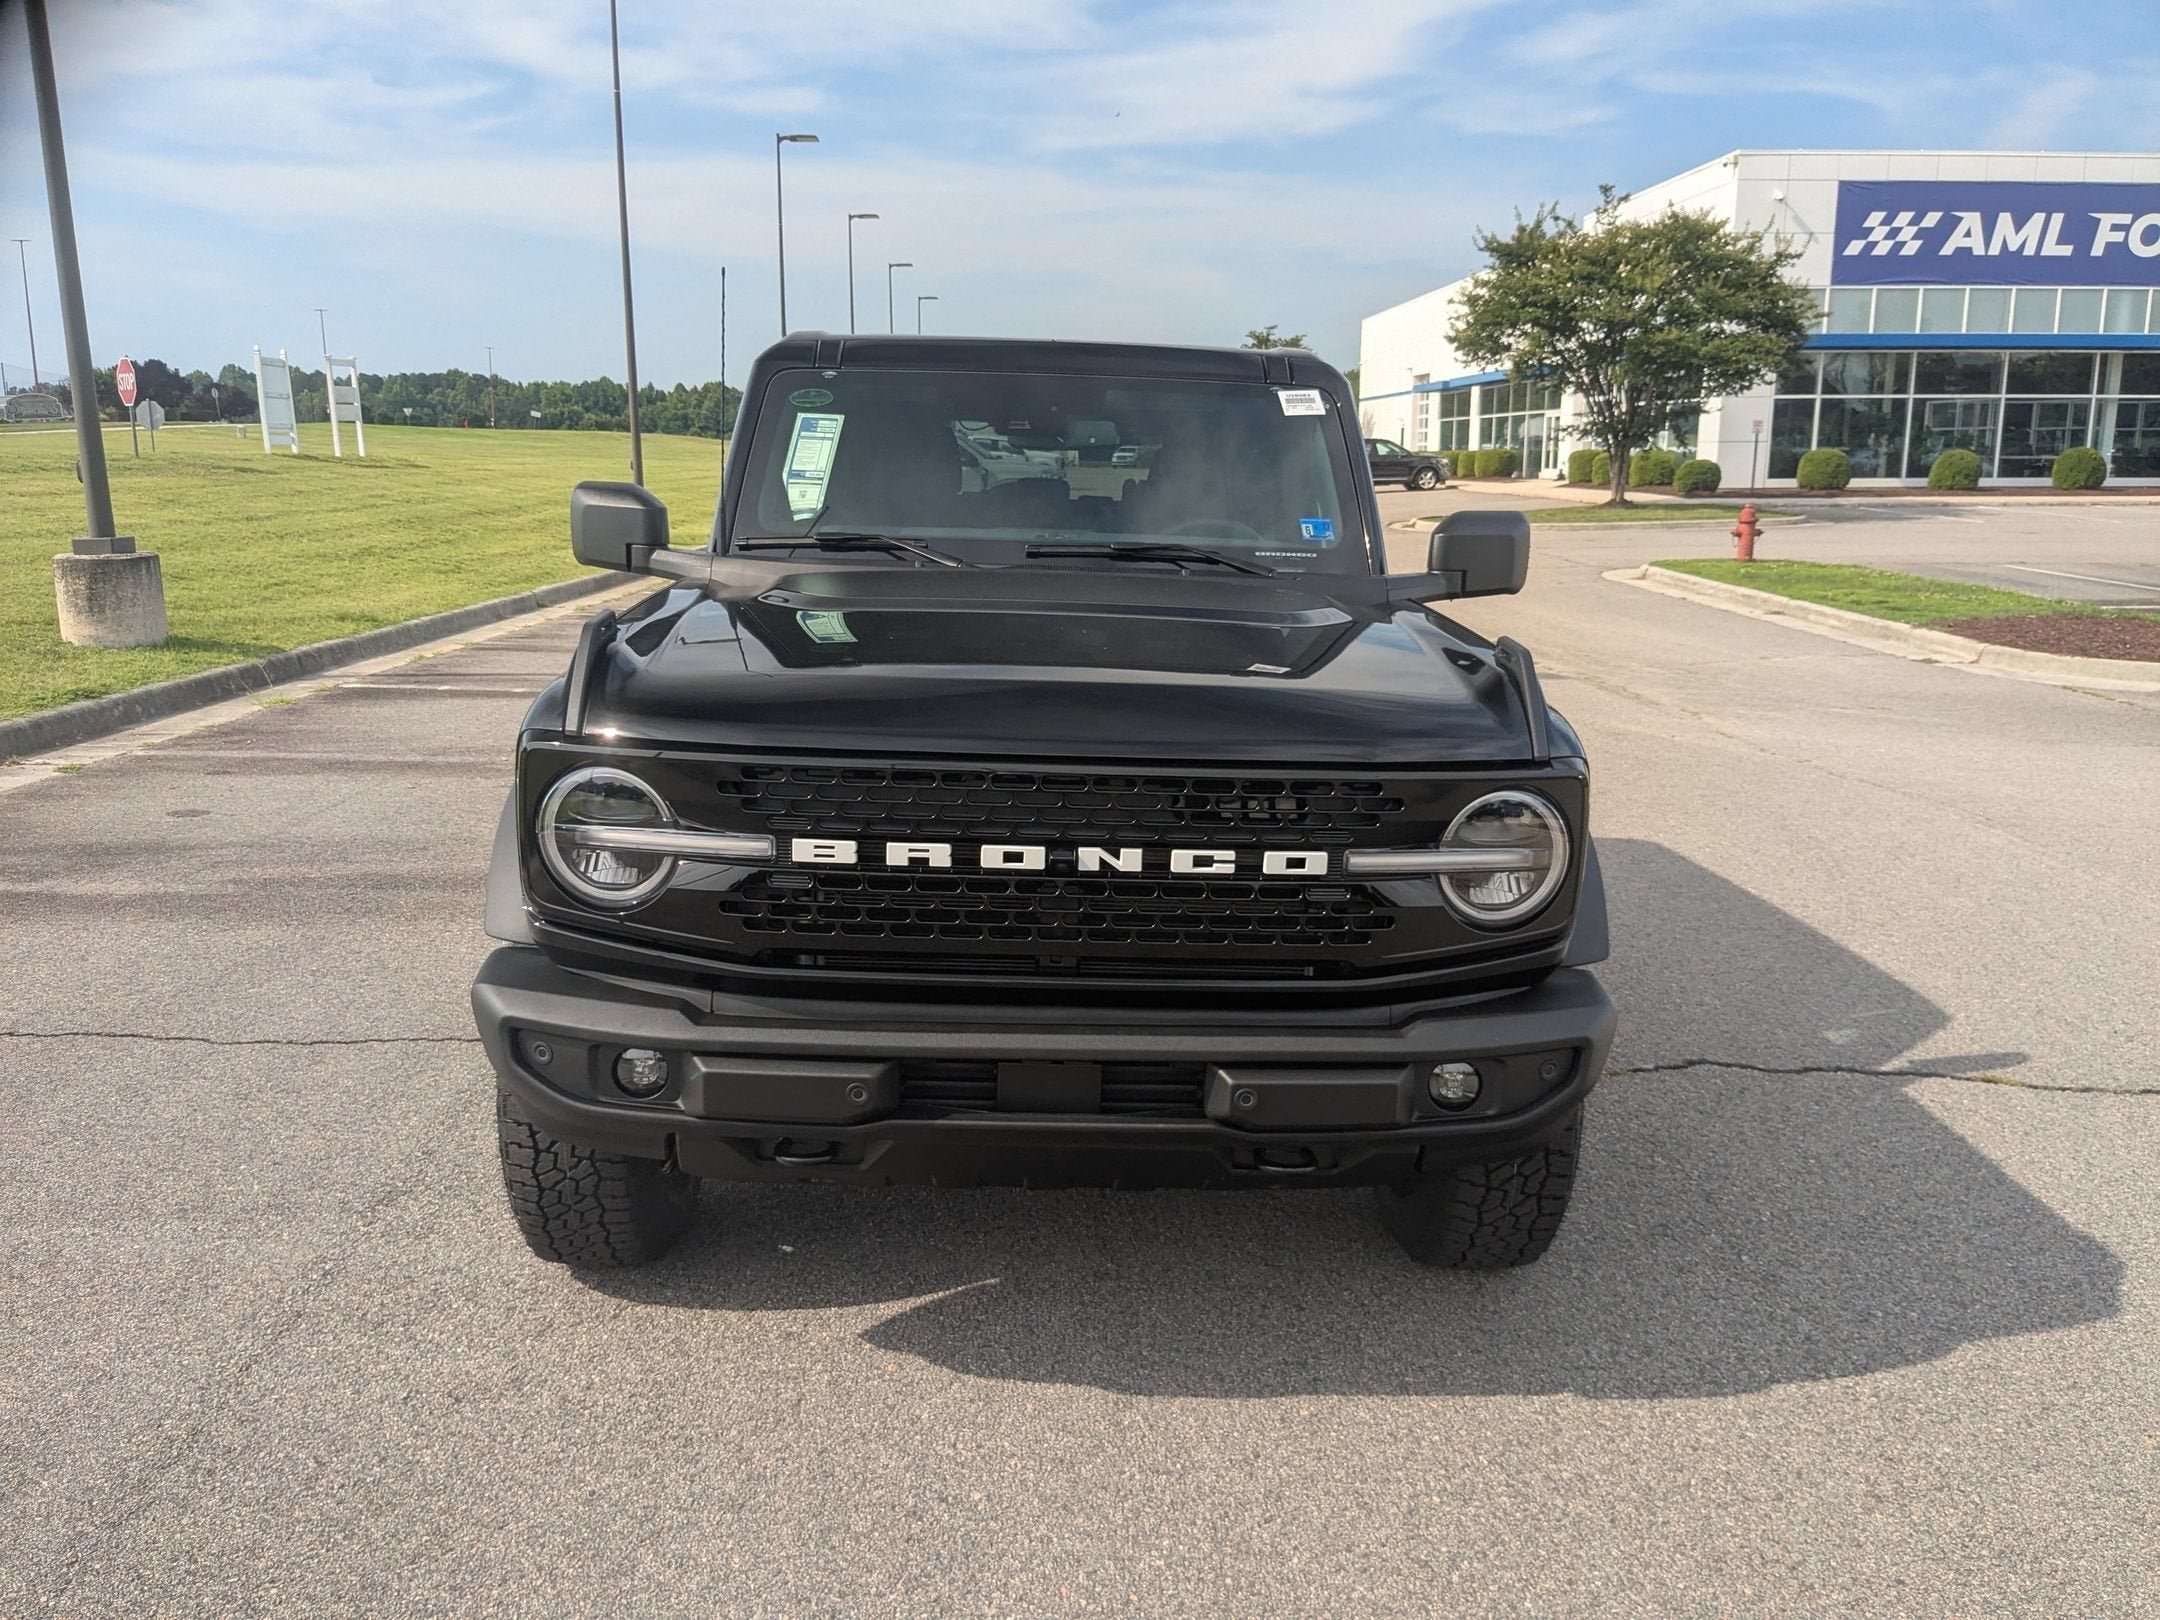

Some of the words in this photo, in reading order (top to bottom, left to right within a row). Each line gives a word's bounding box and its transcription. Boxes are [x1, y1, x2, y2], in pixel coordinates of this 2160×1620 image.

[1938, 211, 2074, 256] AML
[2088, 213, 2160, 258] FO
[118, 372, 134, 391] STOP
[791, 838, 1329, 876] BRONCO
